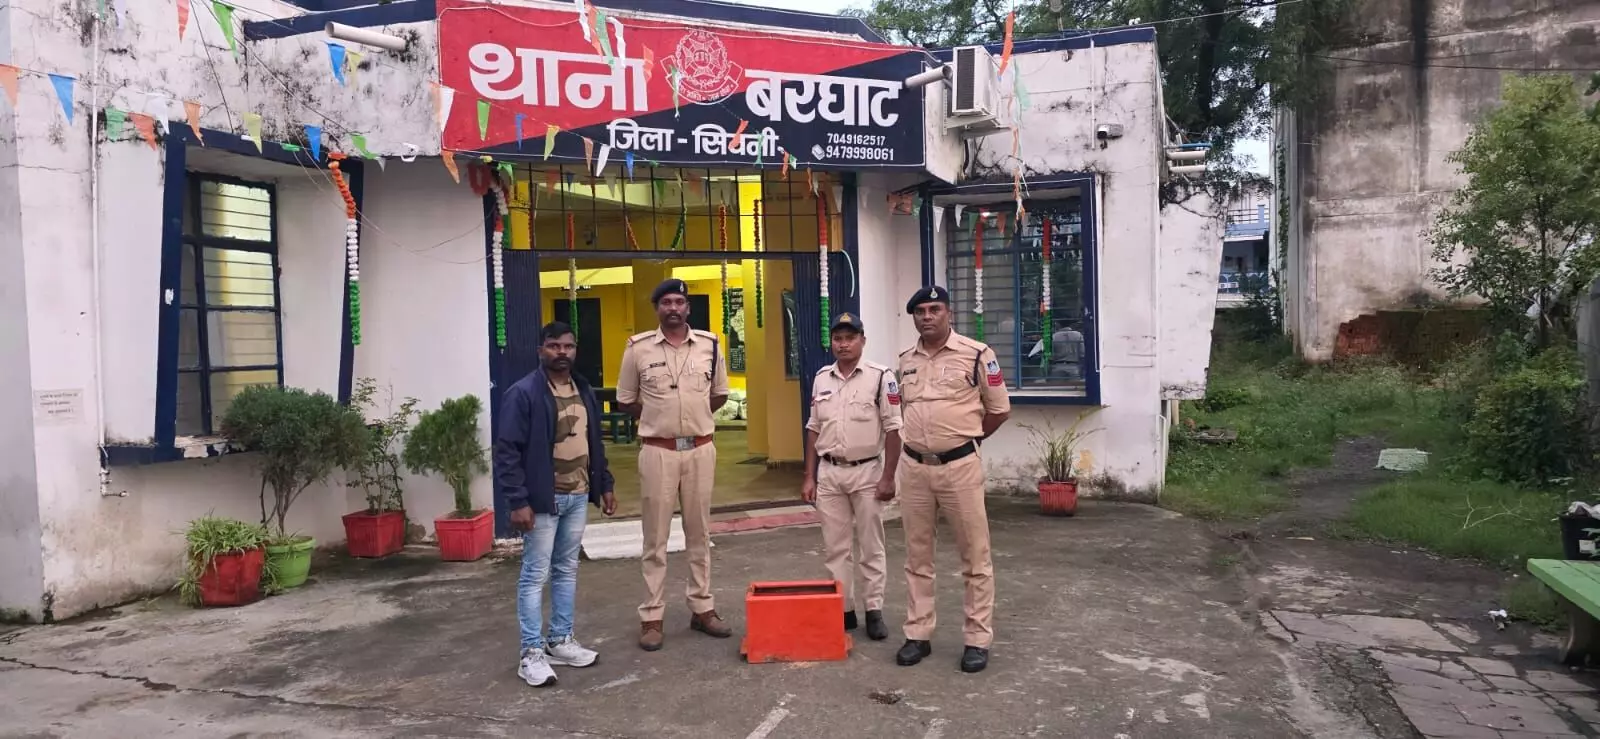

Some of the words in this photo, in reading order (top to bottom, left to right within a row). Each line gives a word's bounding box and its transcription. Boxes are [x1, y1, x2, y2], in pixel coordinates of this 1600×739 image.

[468, 43, 648, 111] थाना
[745, 69, 902, 127] बरघाट
[606, 118, 674, 151] जिला
[692, 124, 779, 156] सिवनी
[827, 133, 886, 146] 7049162517
[826, 145, 894, 161] 9479998061
